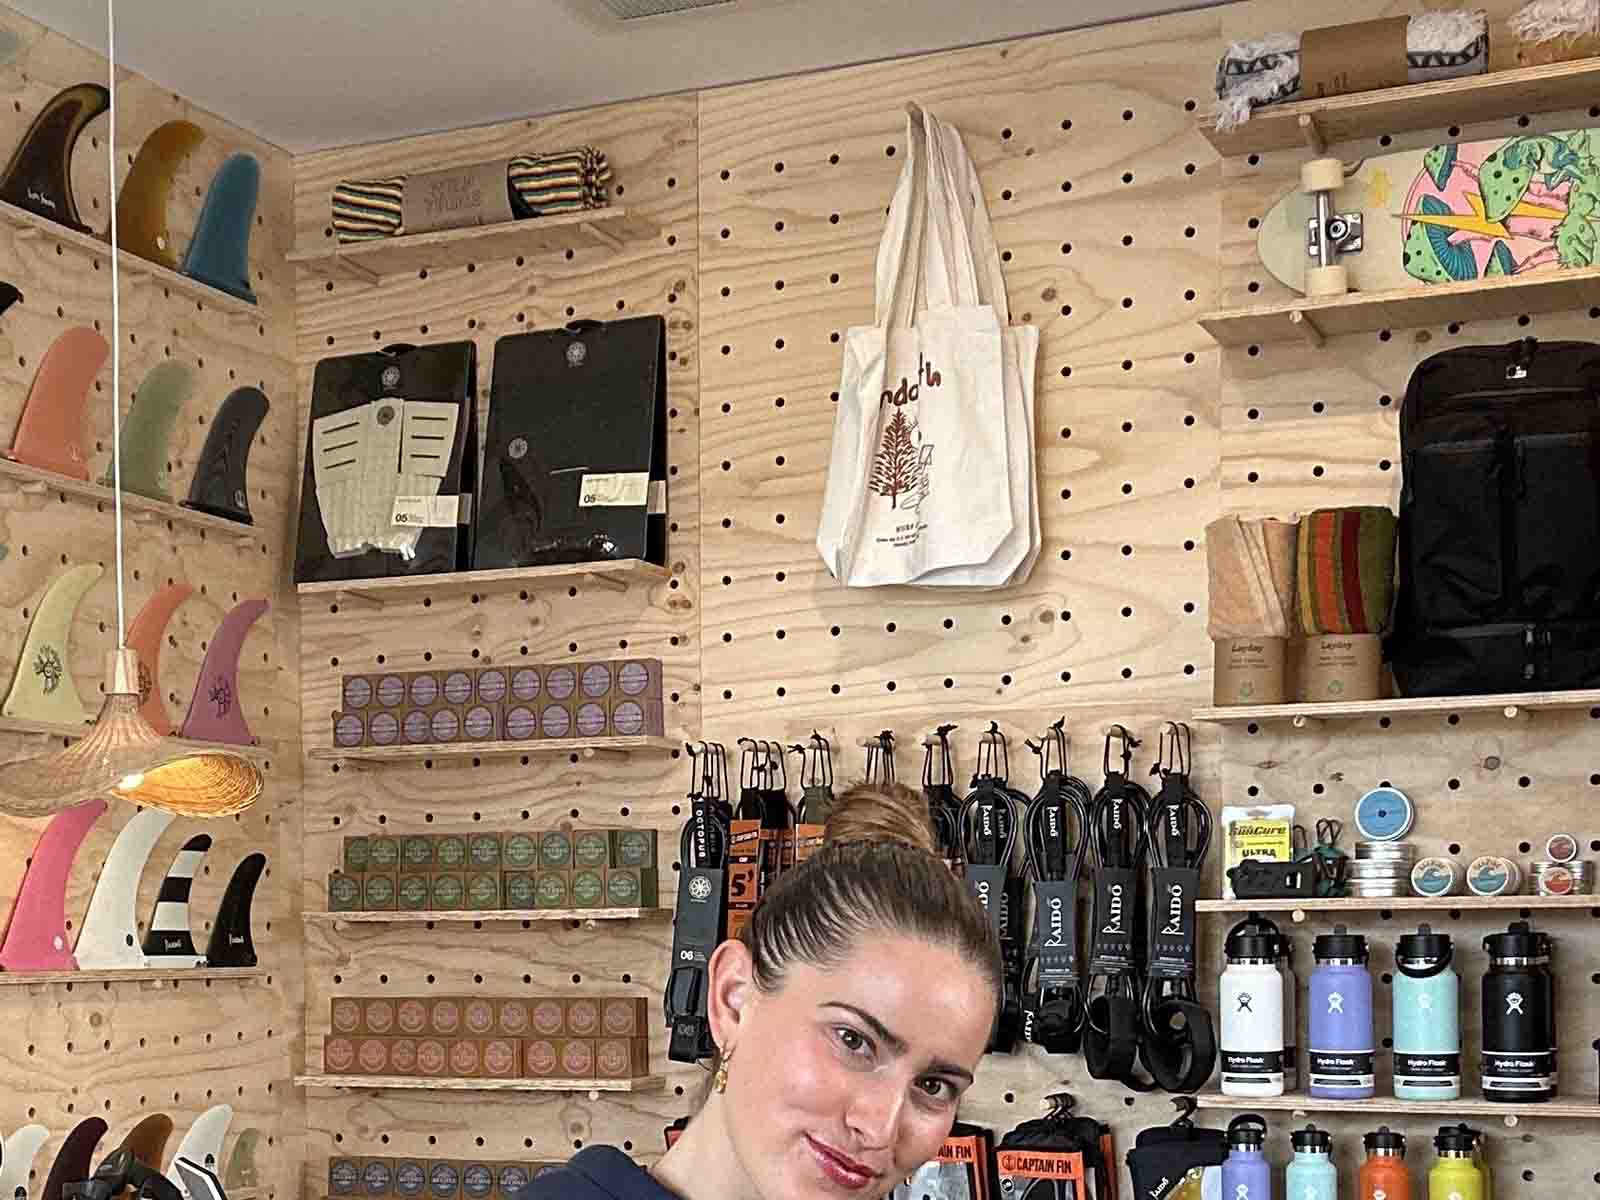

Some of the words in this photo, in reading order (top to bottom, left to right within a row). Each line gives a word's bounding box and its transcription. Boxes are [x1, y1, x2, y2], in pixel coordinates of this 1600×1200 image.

[395, 513, 408, 523] 05
[1242, 848, 1277, 858] ULTRA
[955, 1145, 972, 1158] FIN
[1016, 1157, 1054, 1173] CAPTAIN
[1056, 1159, 1072, 1173] FIN
